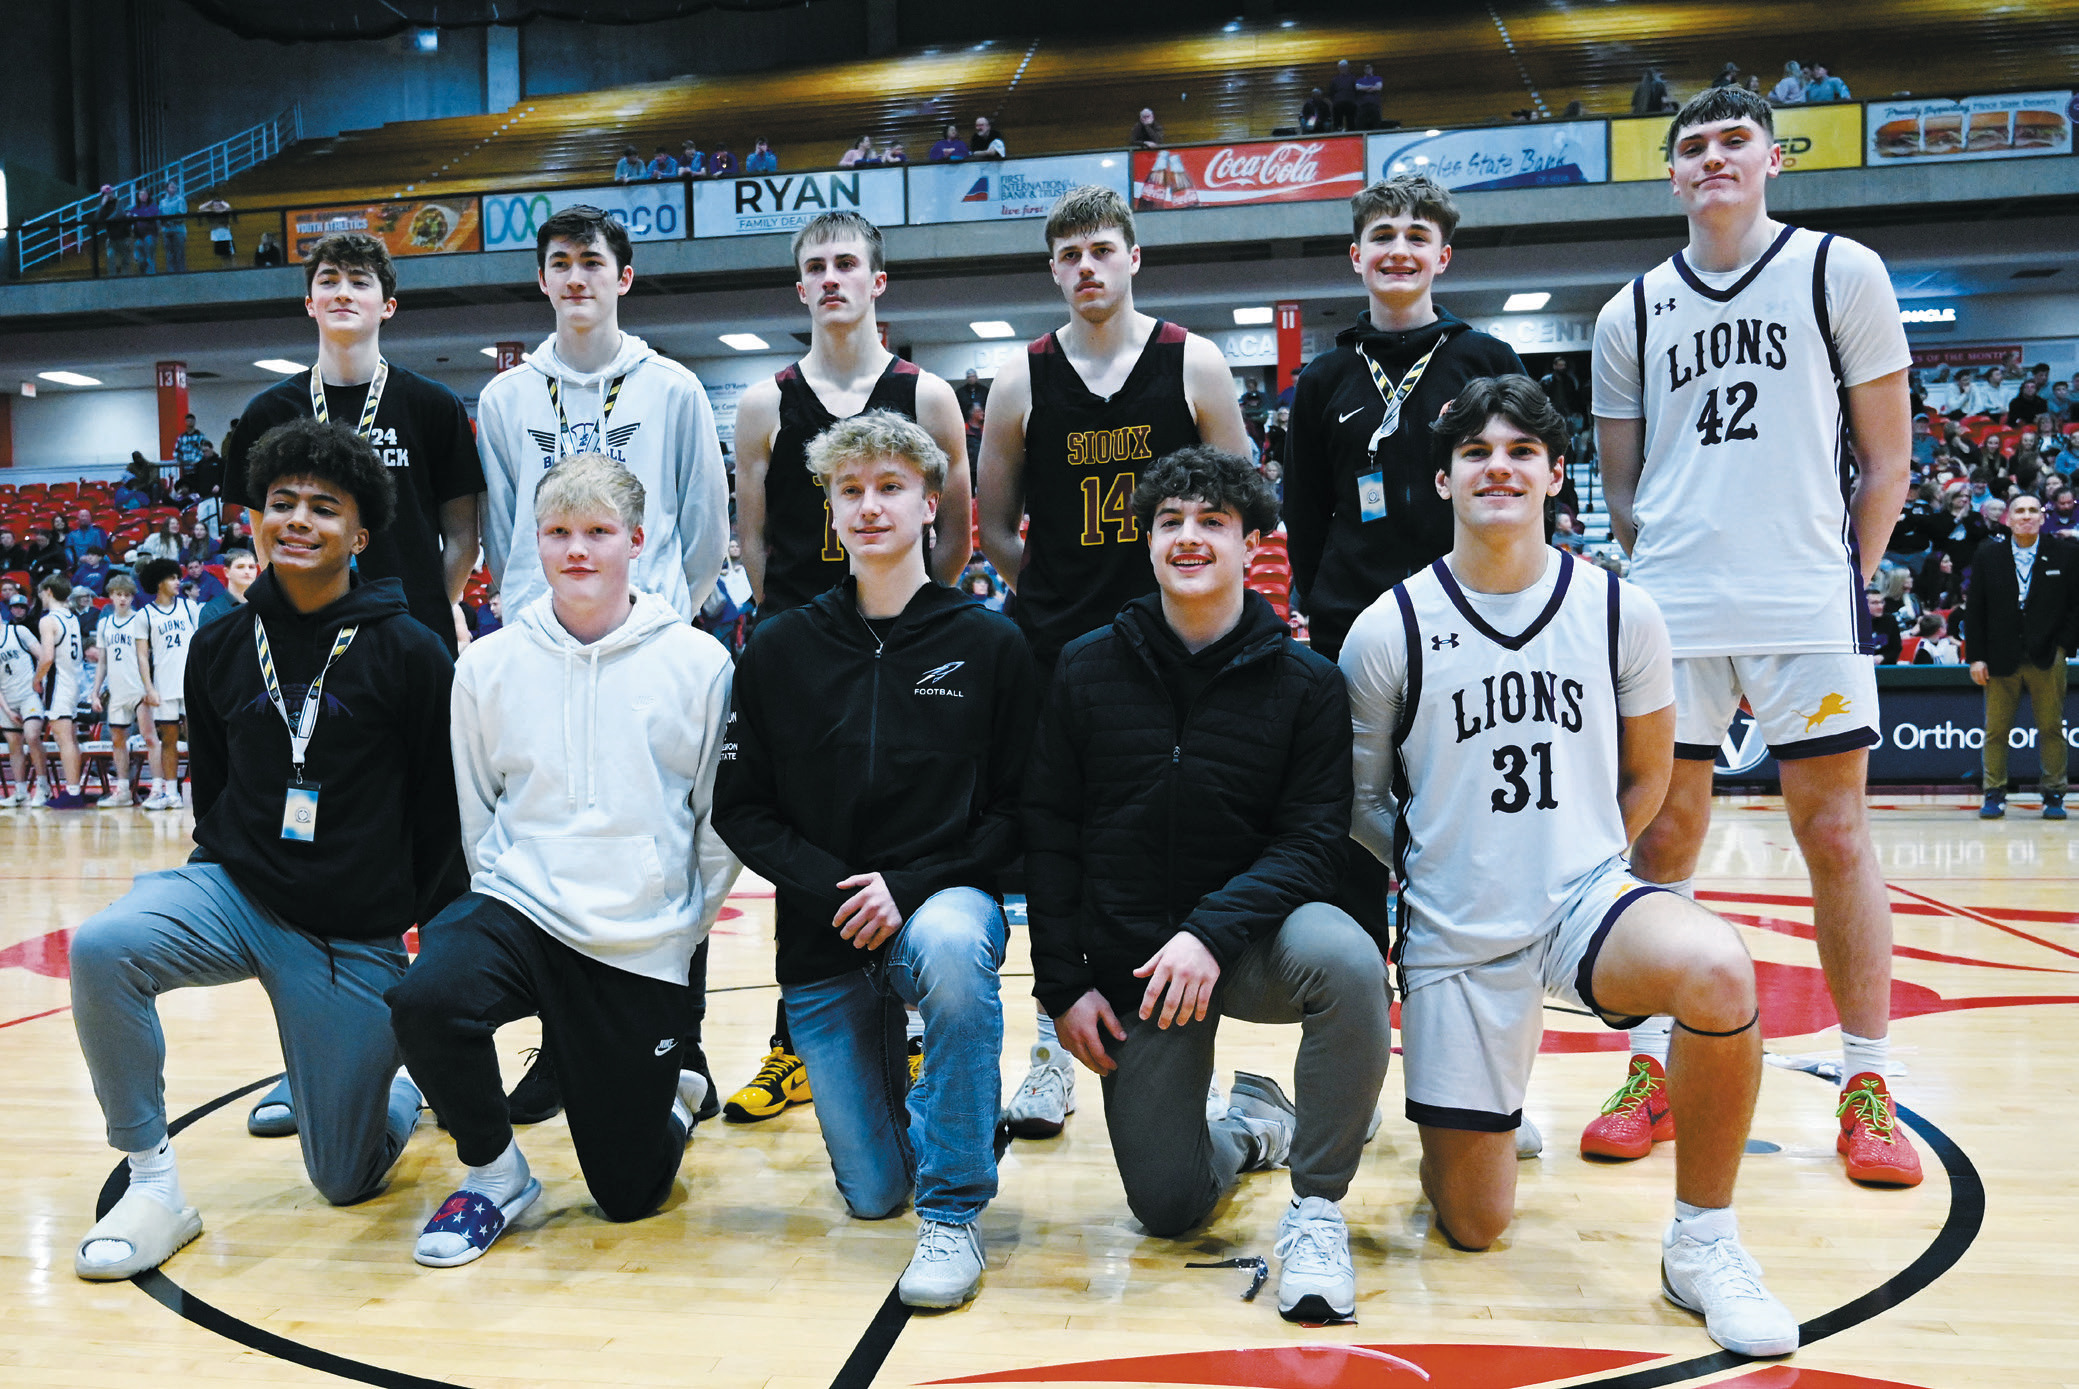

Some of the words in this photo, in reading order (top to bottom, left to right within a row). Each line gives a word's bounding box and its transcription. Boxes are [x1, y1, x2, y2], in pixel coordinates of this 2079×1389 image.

[1469, 152, 1513, 176] State
[1520, 143, 1568, 173] Bank
[1001, 175, 1024, 184] FIRST
[735, 173, 861, 214] RYAN
[1001, 191, 1026, 200] BANK
[1029, 190, 1037, 199] &
[296, 221, 323, 233] YOUTH
[324, 218, 369, 231] ATHLETICS
[739, 218, 778, 229] FAMILY
[1282, 311, 1295, 329] 11
[1518, 320, 1591, 343] CENT
[499, 352, 515, 369] 12
[1667, 319, 1787, 393] LIONS
[1696, 381, 1759, 446] 42
[1067, 425, 1152, 465] SIOUX
[1081, 472, 1139, 546] 14
[158, 619, 186, 636] LIONS
[71, 634, 78, 661] 5
[107, 633, 133, 647] LIONS
[166, 634, 182, 649] 24
[115, 648, 123, 662] 2
[5, 663, 12, 676] 4
[914, 688, 964, 698] FOOTBALL
[1452, 671, 1584, 743] LIONS
[720, 753, 737, 761] TATE
[1491, 742, 1559, 814] 31
